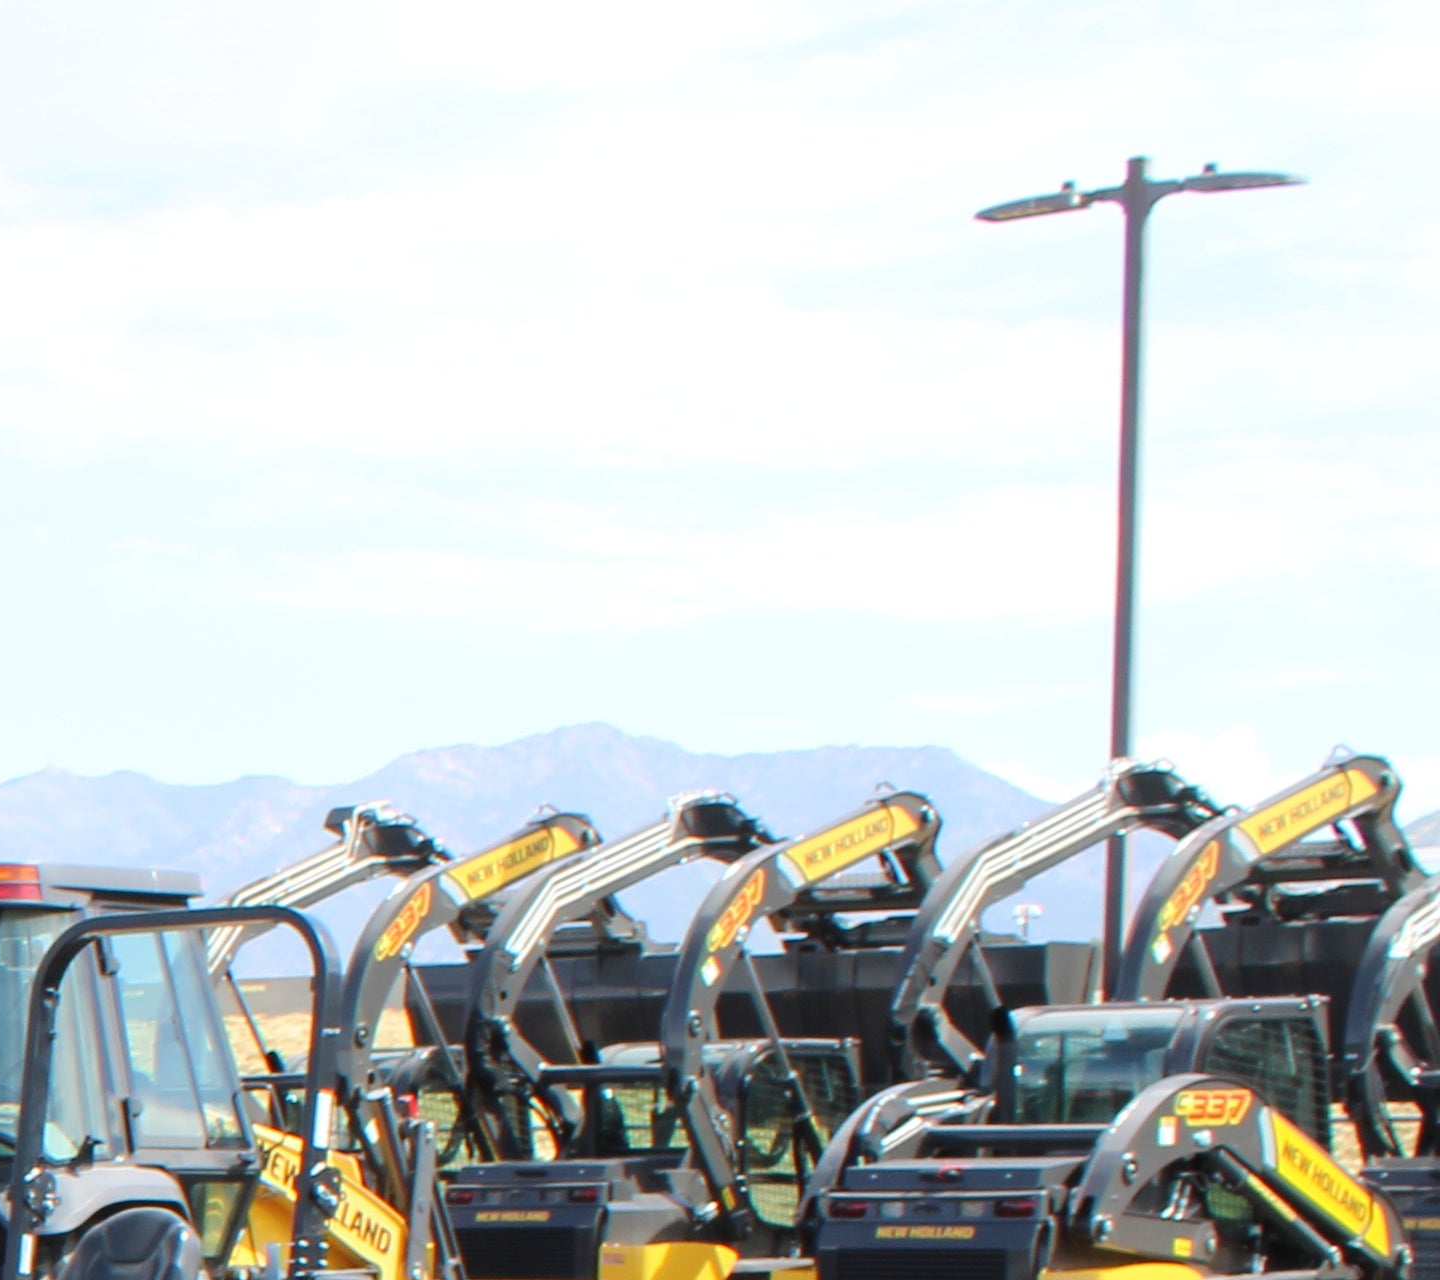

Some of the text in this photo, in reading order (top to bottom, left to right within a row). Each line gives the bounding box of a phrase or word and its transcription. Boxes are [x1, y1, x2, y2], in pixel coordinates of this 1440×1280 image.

[1174, 1088, 1254, 1127] C337
[1283, 1139, 1313, 1180] NEW
[1311, 1164, 1367, 1222] HOLLAND
[876, 1225, 977, 1239] NEW HOLLAND
